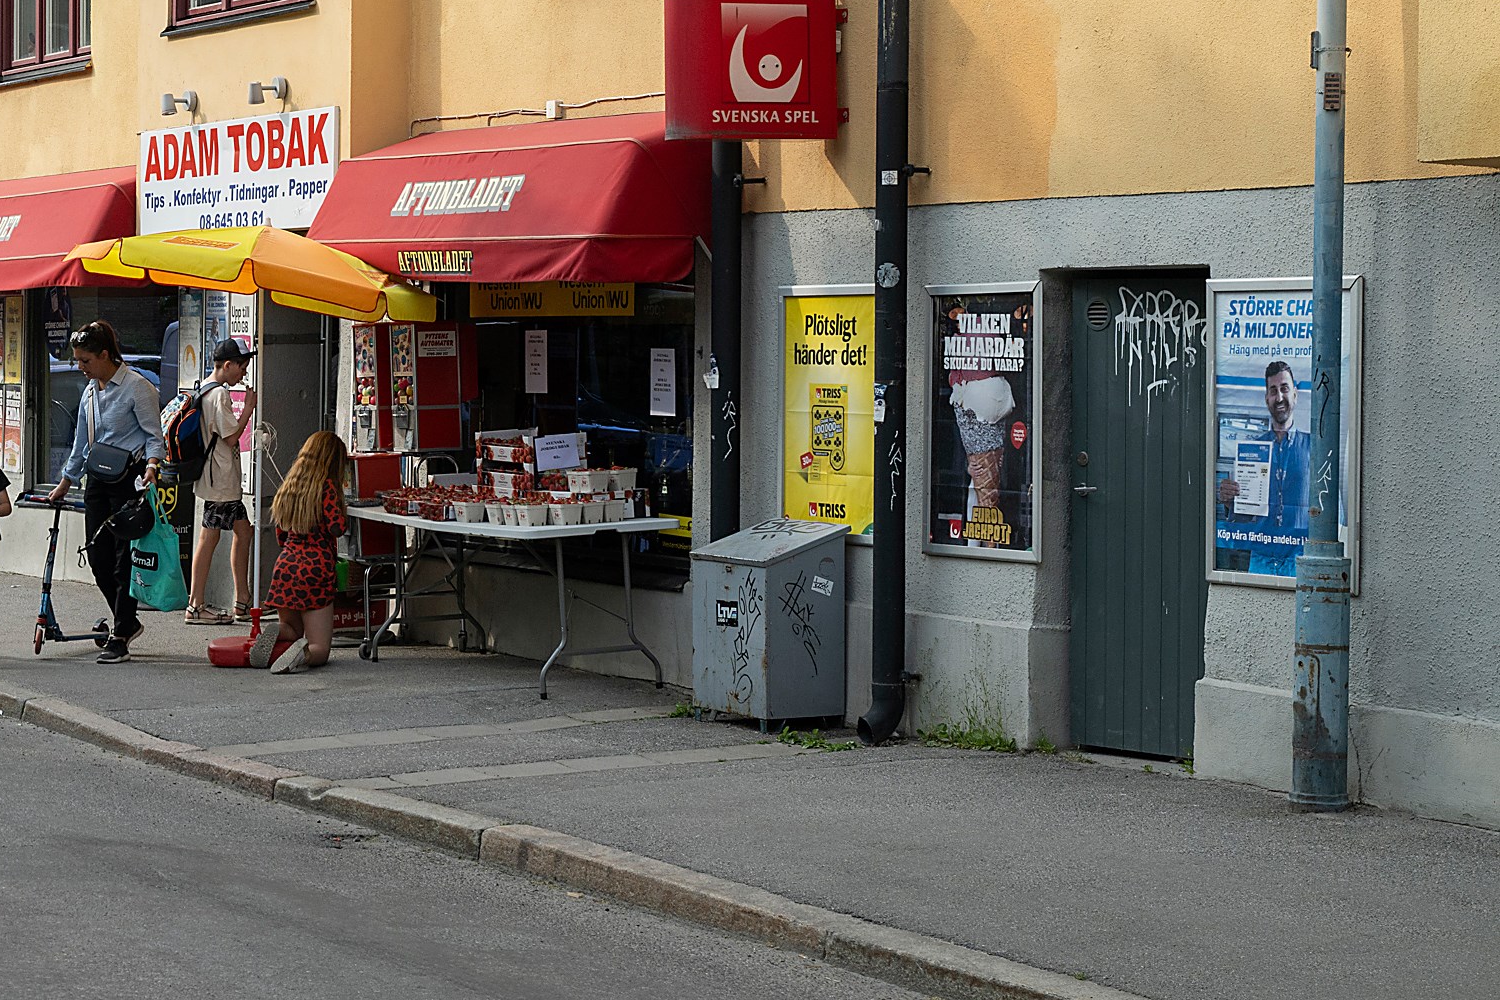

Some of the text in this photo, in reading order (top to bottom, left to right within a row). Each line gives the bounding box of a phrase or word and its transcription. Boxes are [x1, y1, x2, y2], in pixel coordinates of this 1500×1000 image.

[712, 109, 819, 124] SVENSKA SPEL
[144, 112, 330, 183] ADAM TOBAK
[145, 193, 165, 212] Tips
[288, 178, 328, 200] Papper
[390, 174, 526, 217] AFTONBLADET
[398, 250, 473, 275] AFTONBLADET
[490, 292, 520, 310] Union
[573, 289, 605, 309] Union
[1229, 296, 1313, 316] STÖRRE CHA
[232, 305, 250, 320] Upp till
[804, 313, 857, 342] Plötsligt
[957, 314, 1011, 334] VILKEN
[1223, 318, 1313, 339] PÅ MILJONER
[794, 343, 868, 366] händer det!
[944, 334, 1025, 358] MILJARDÄR
[1229, 344, 1312, 358] Häng med på en prof
[944, 358, 1024, 372] SKULLE DU VARA?
[822, 388, 842, 398] TRISS
[818, 502, 846, 518] TRISS
[972, 506, 1004, 524] EURO
[962, 522, 1012, 544] JACKPOT
[1217, 530, 1230, 541] Köp
[1232, 530, 1248, 540] våra
[1248, 532, 1272, 544] färdiga
[1273, 535, 1300, 546] andelar
